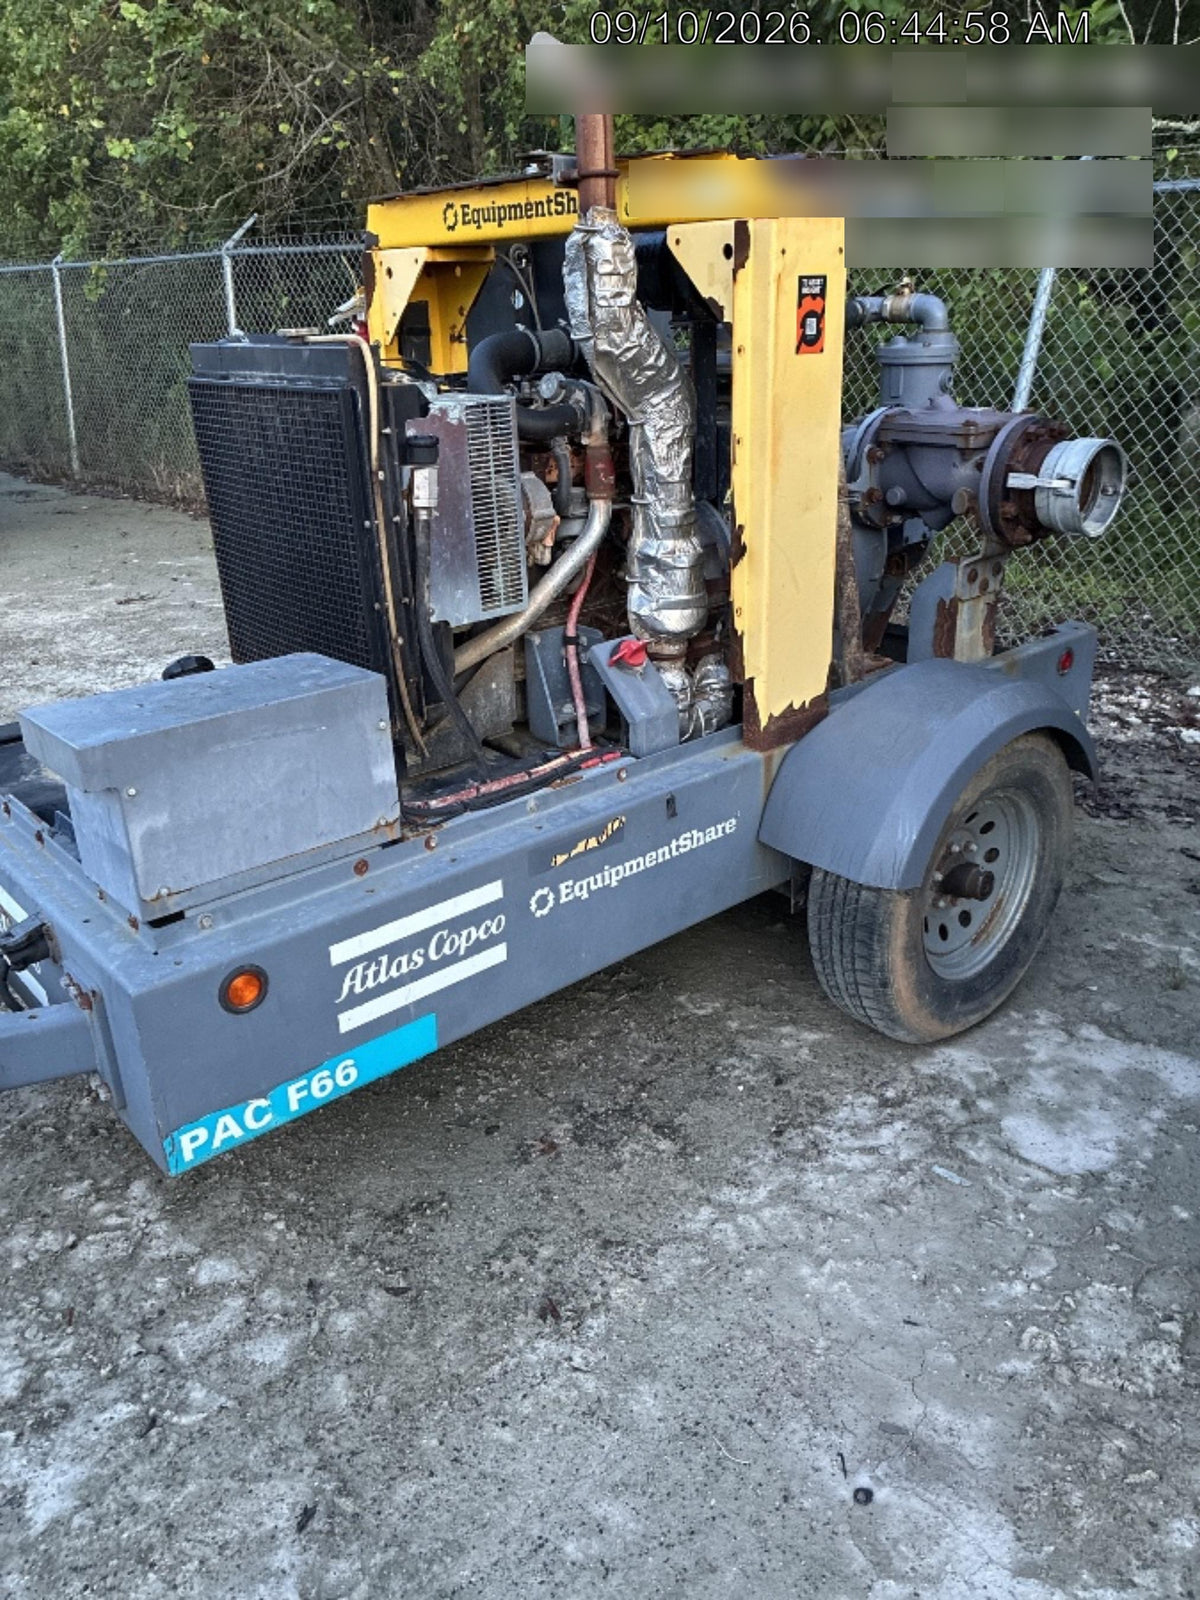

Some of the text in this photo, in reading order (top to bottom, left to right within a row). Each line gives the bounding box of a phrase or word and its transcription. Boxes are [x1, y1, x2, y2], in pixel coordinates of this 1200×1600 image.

[460, 192, 578, 230] EquipmentSh
[559, 816, 737, 903] EquipmentShare
[335, 914, 506, 1003] Atlas Copco
[179, 1059, 358, 1162] PAC F66
